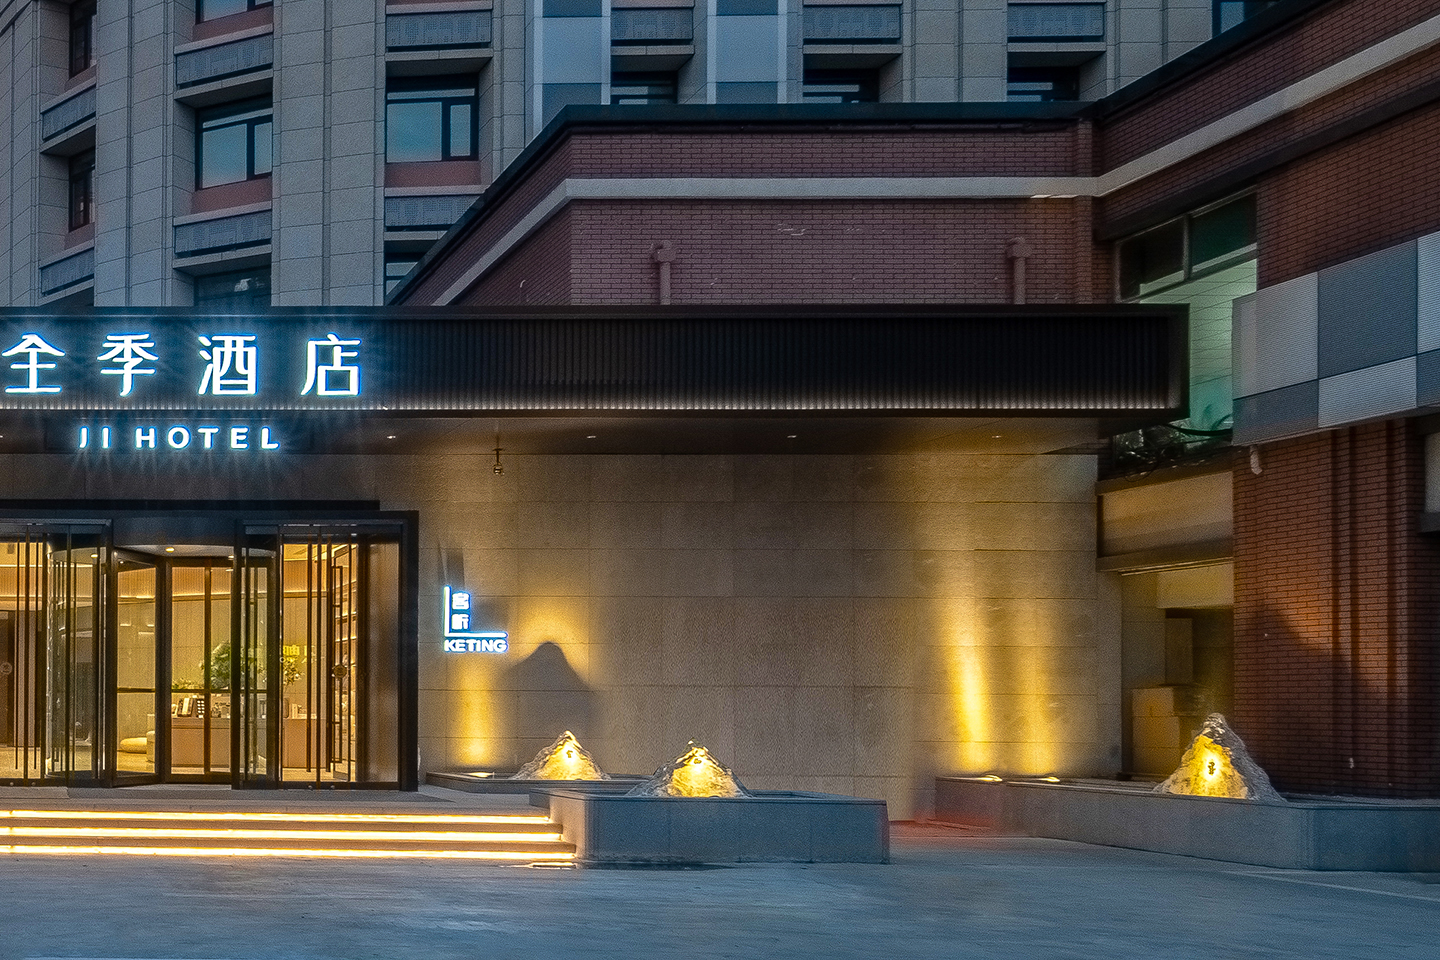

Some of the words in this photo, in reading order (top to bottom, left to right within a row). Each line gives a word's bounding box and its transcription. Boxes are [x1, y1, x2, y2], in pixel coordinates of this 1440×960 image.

[1, 332, 362, 397] 全季酒店
[78, 426, 111, 449] JI
[134, 426, 280, 450] HOTEL
[443, 639, 509, 653] KETING
